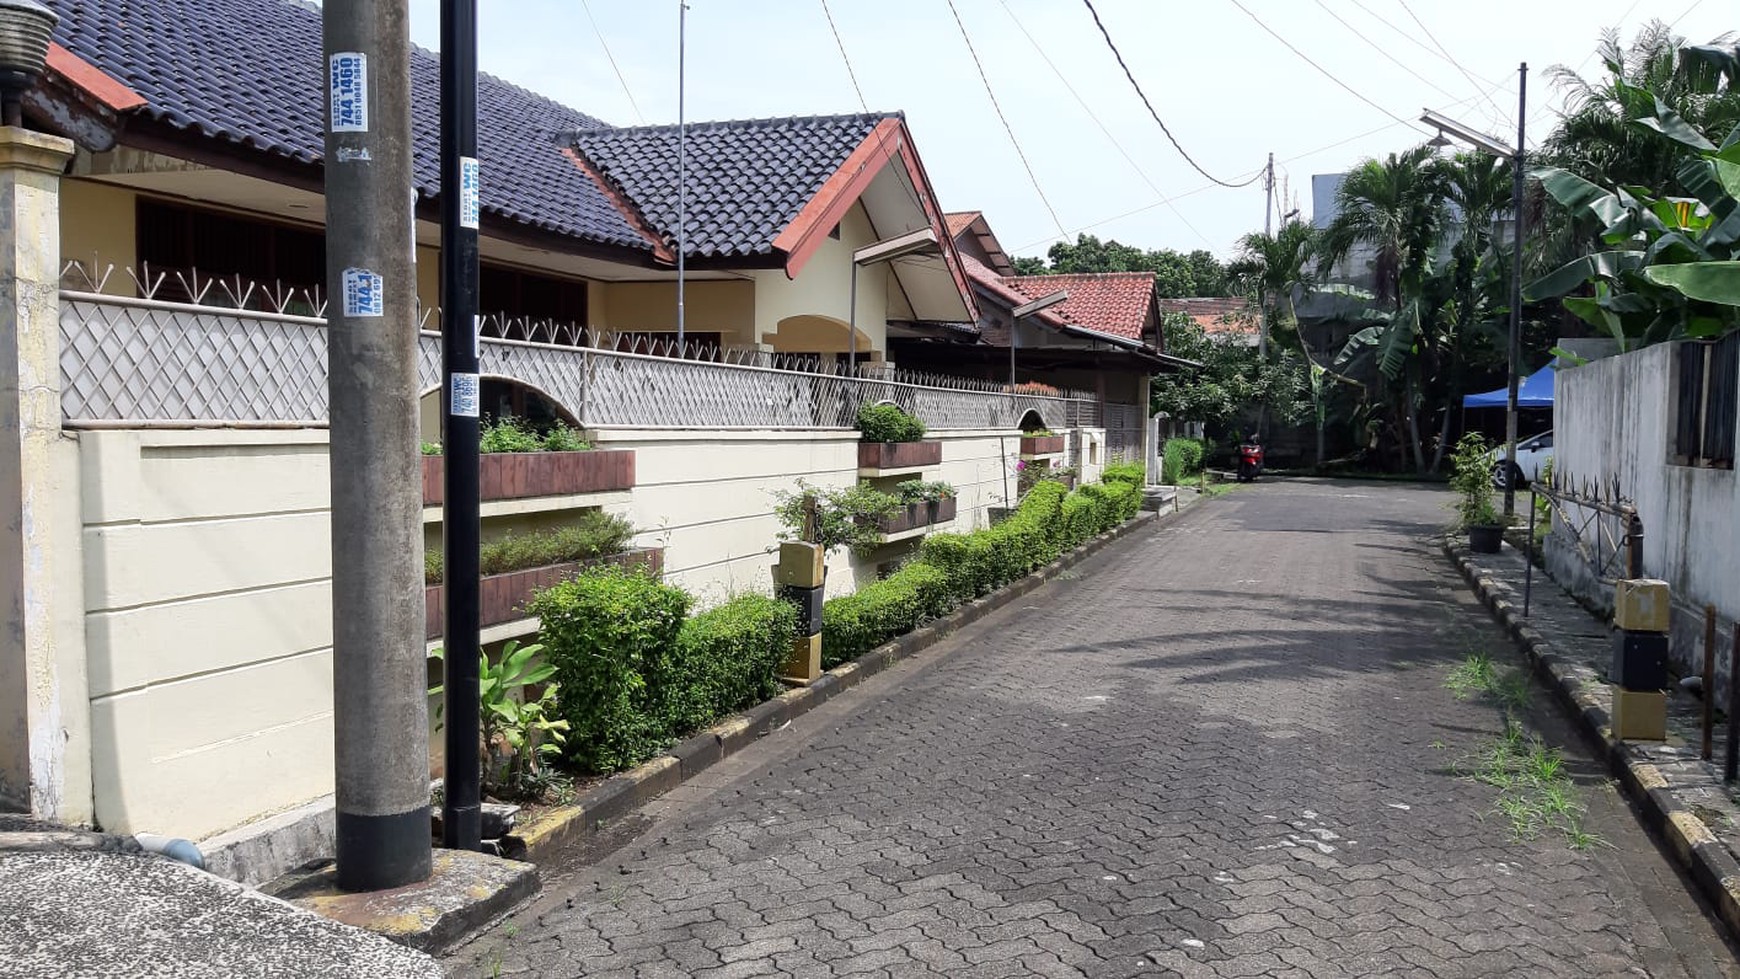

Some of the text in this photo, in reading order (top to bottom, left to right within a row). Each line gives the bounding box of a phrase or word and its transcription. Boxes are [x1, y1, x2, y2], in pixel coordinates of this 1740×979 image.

[332, 59, 339, 90] WC
[340, 57, 354, 127] 744 1460
[464, 161, 471, 189] WC
[357, 286, 372, 314] 744
